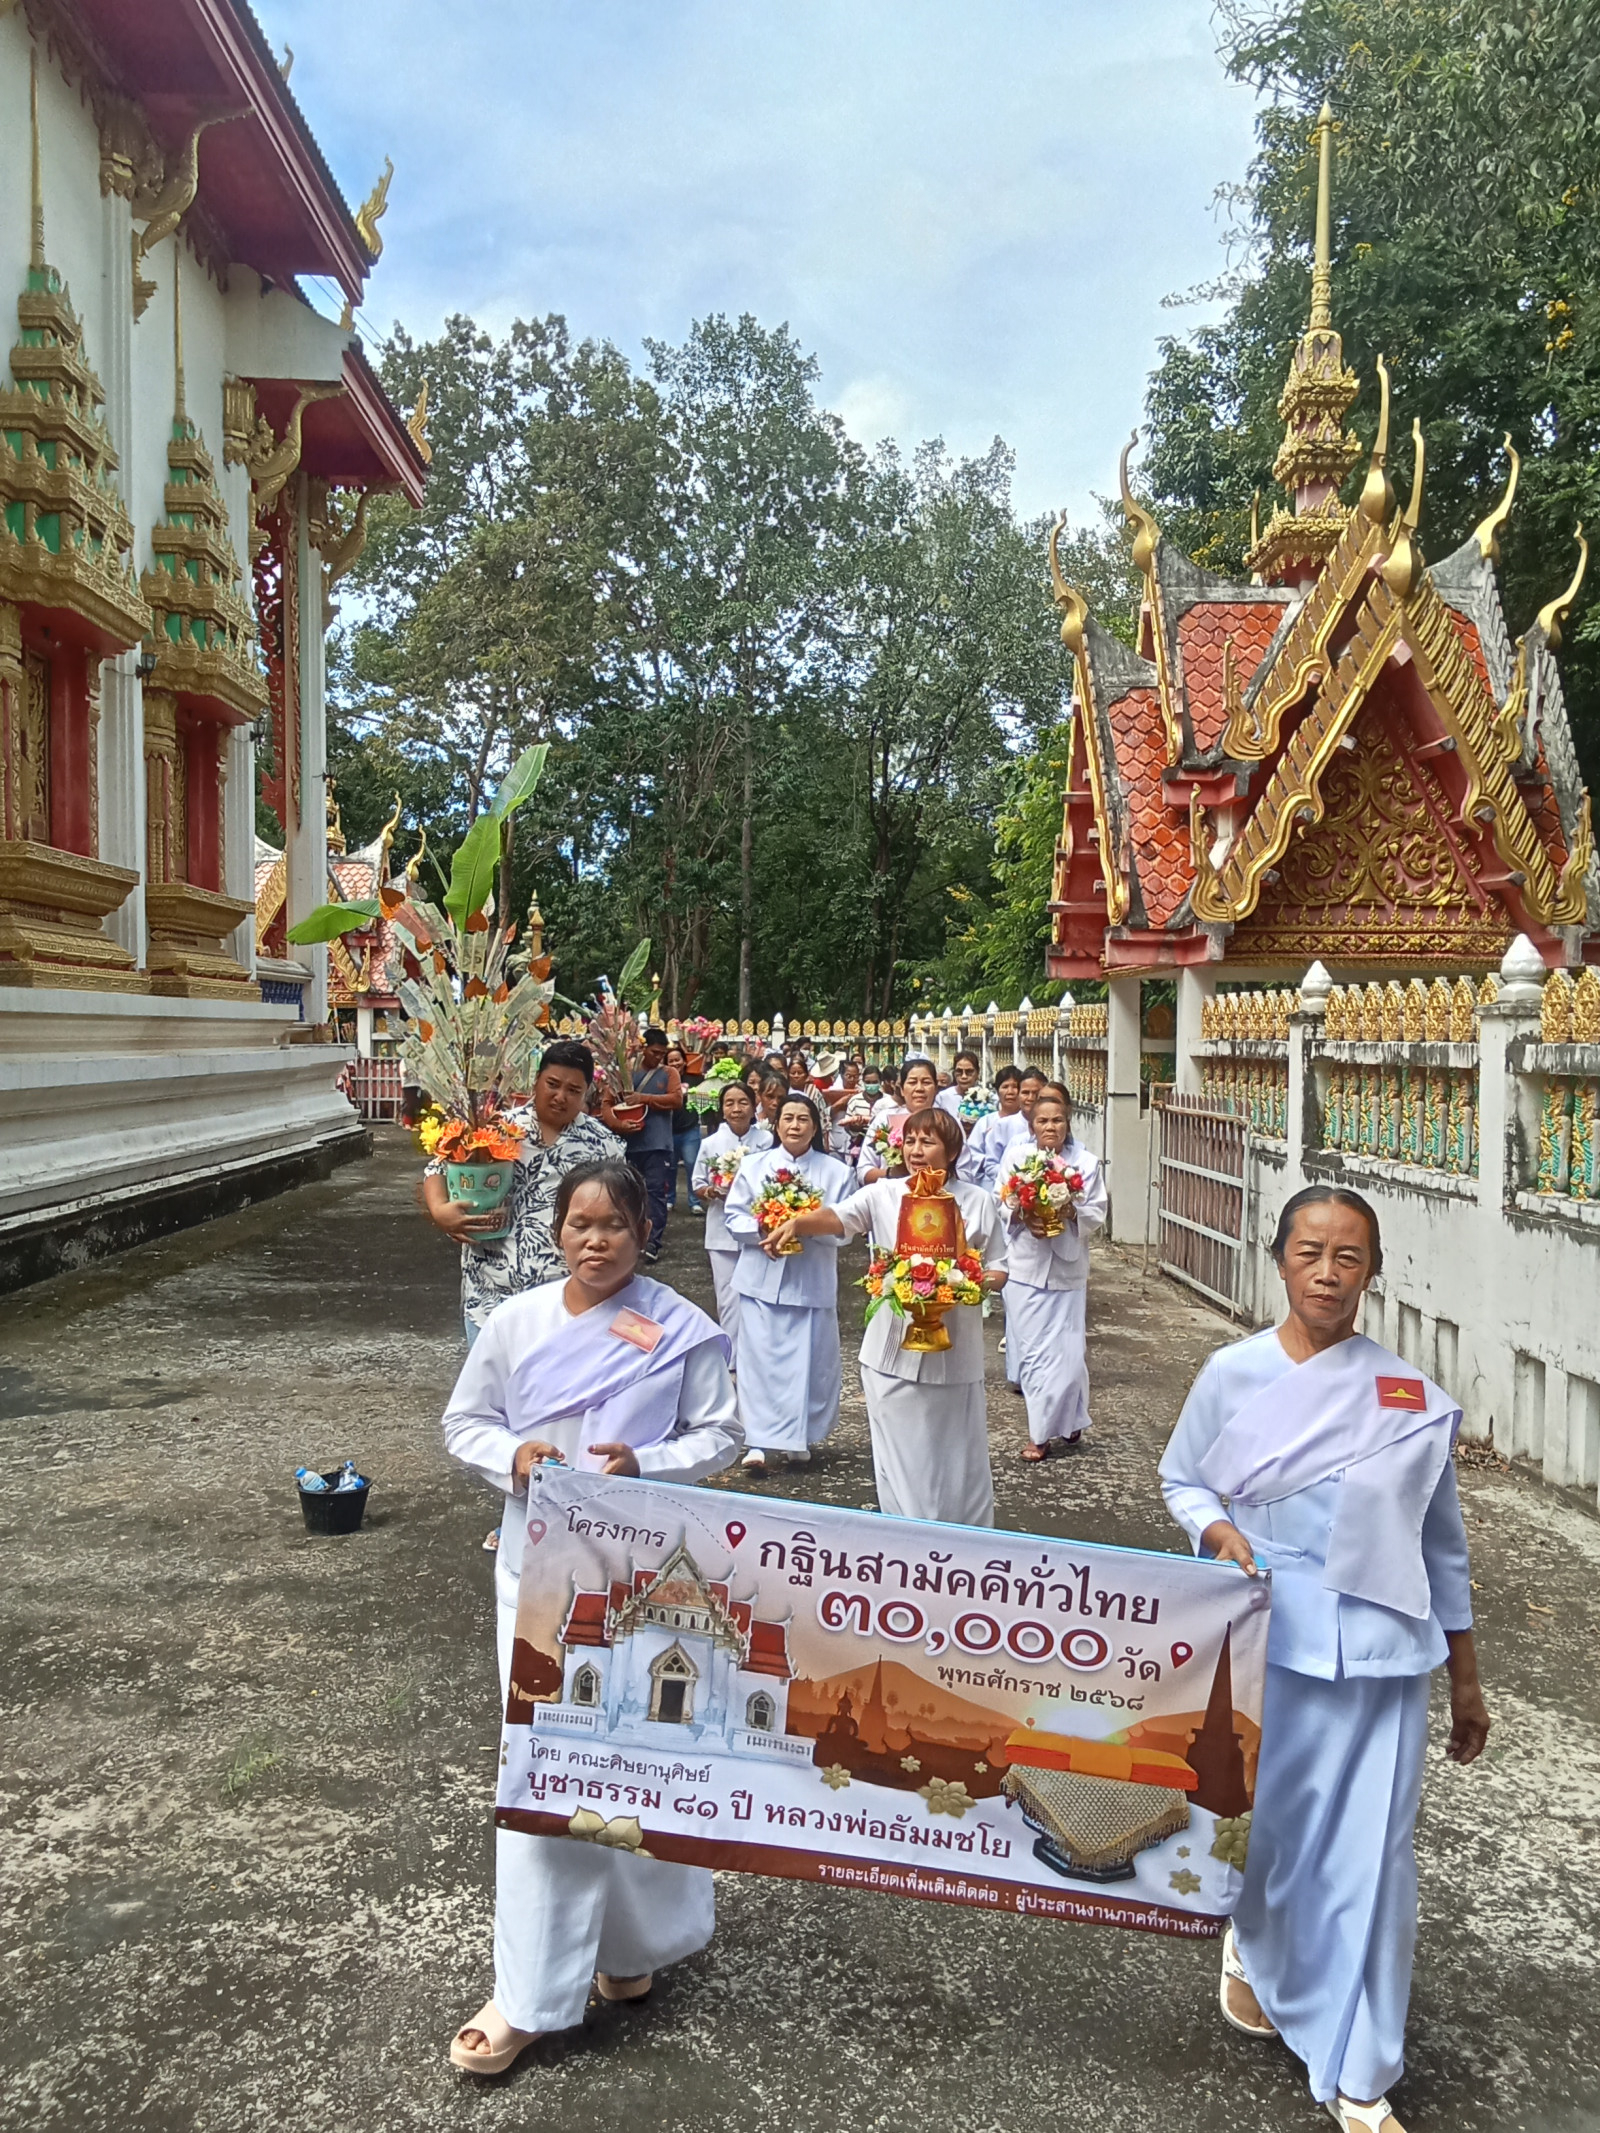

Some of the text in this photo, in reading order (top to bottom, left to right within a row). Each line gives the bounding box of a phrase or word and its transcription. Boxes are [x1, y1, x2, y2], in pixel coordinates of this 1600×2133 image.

[566, 1505, 667, 1547] โครงการ
[759, 1531, 1160, 1625] กฐินสามัคคีทั่วไทย
[818, 1590, 1162, 1683] ๓๐,๐๐๐ วัด
[937, 1665, 1145, 1711] พุทธศักราช ๒๕๖๘
[529, 1738, 713, 1785] โดย คณะศิษยานุศิษย์
[527, 1771, 1012, 1858] บูชาธรรม ๘๑ ปี หลวงพ่อธัมมชโย
[1015, 1888, 1222, 1936] ผู้ประสานงานภาคที่ท่านสังกั
